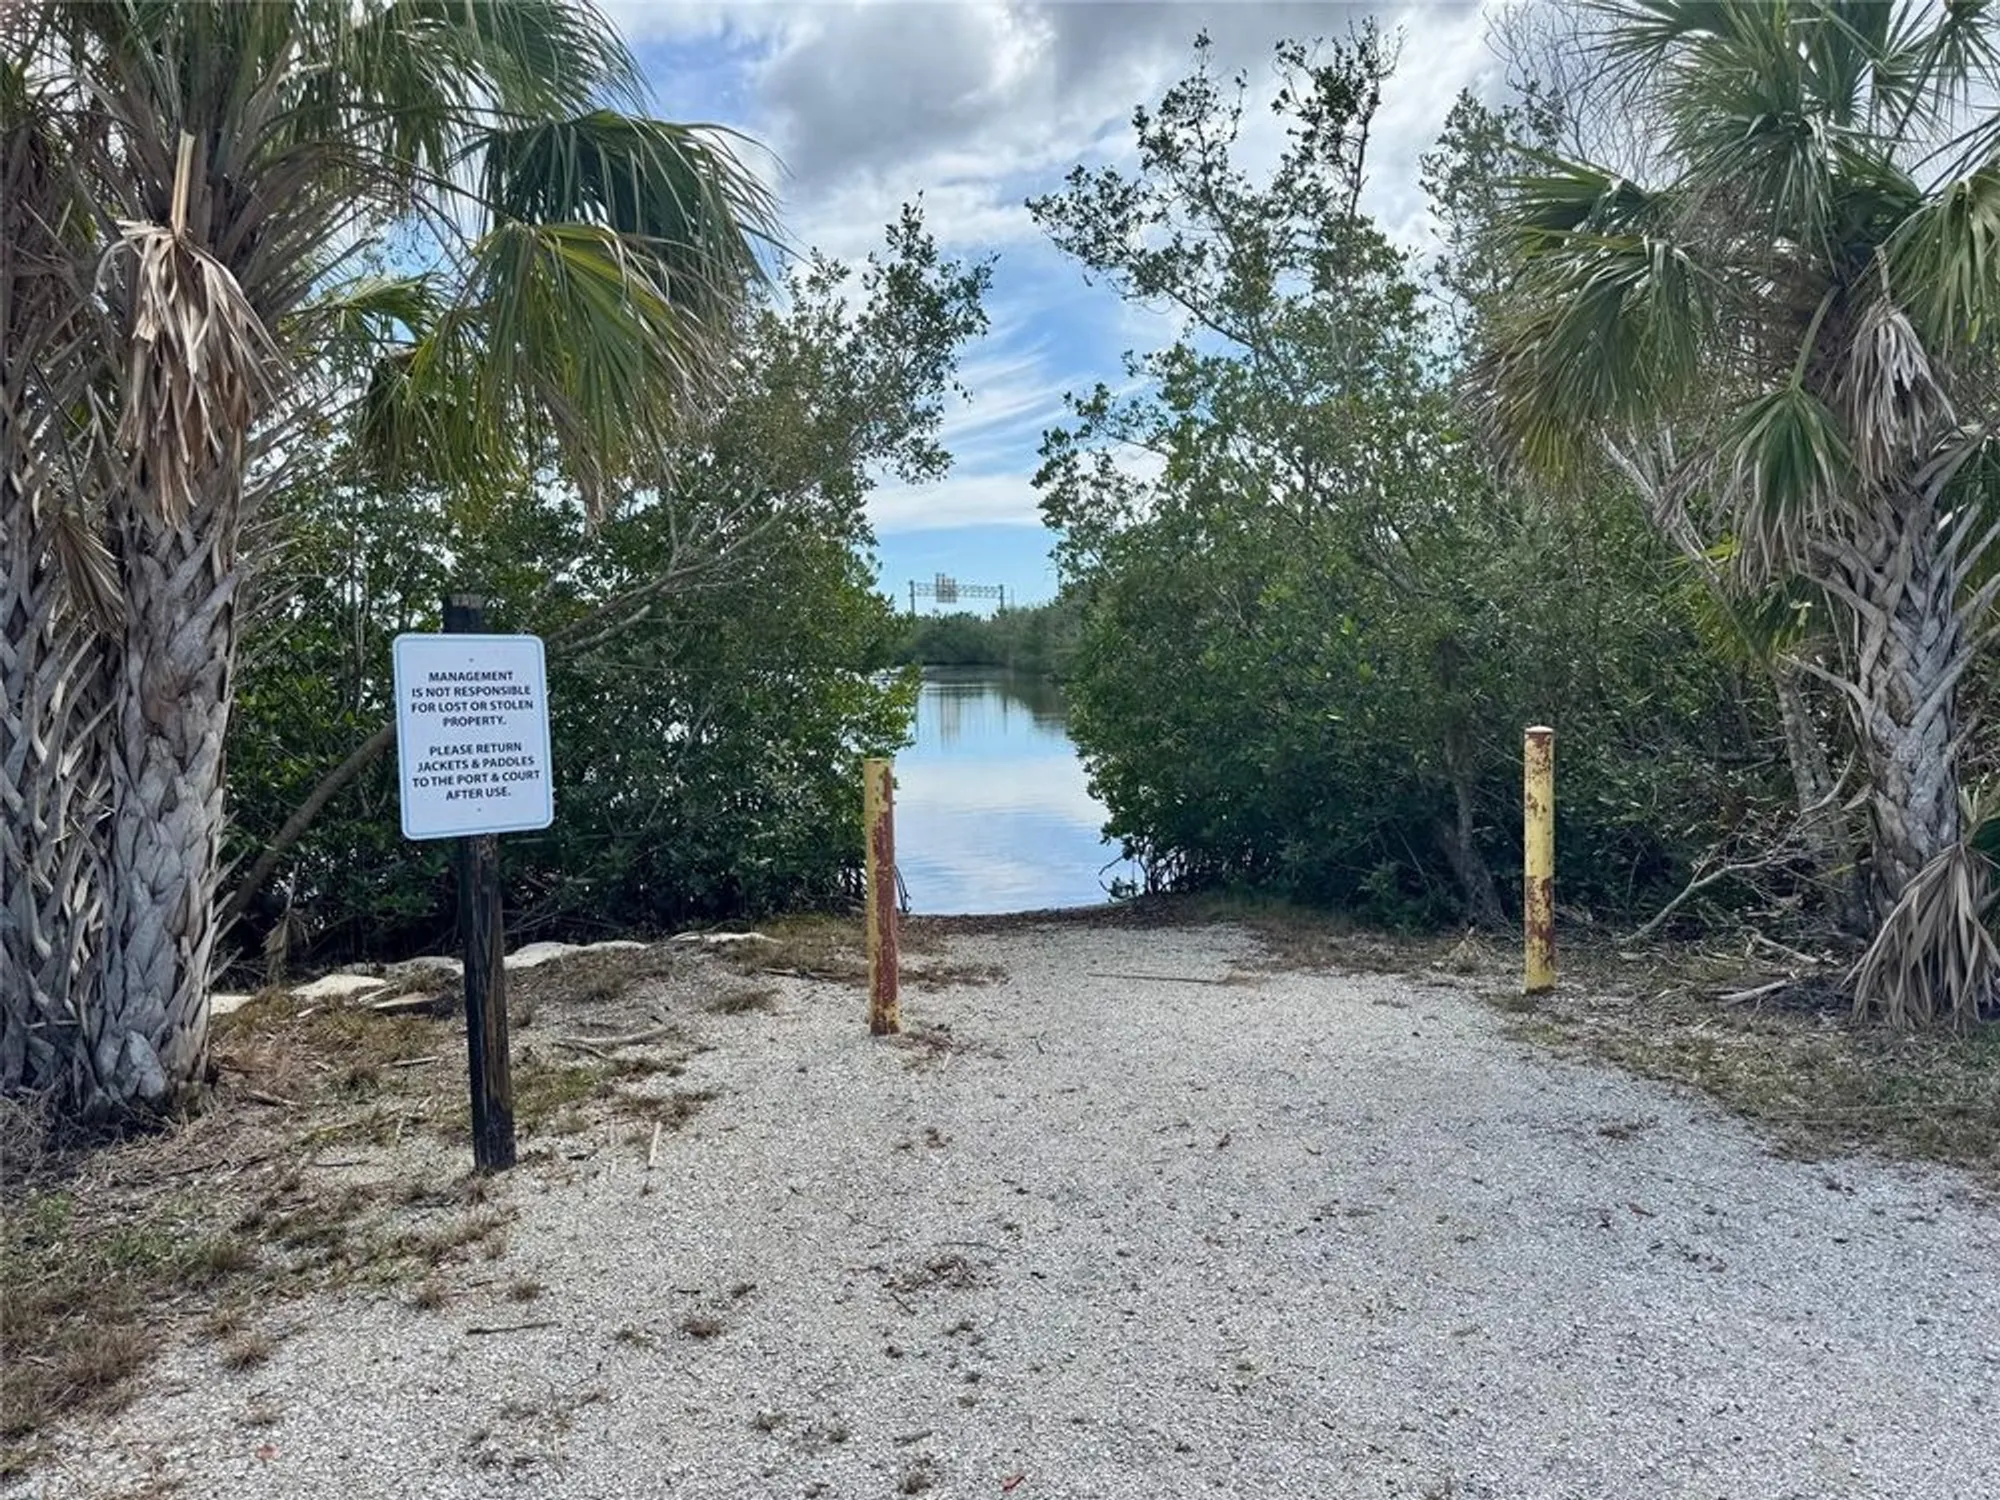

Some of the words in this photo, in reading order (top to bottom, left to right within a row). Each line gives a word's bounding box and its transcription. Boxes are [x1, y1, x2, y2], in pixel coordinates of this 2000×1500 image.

[429, 671, 513, 682] MANAGEMENT
[412, 688, 423, 697] IS
[426, 687, 450, 697] NOT
[454, 685, 531, 697] RESPONSIBLE
[411, 703, 436, 713] FOR
[438, 702, 467, 712] LOST
[470, 702, 487, 711] OR
[490, 700, 533, 710] STOLEN
[443, 716, 506, 727] PROPERTY.
[430, 745, 472, 755] PLEASE
[476, 742, 521, 754] RETURN
[418, 759, 468, 772] JACKETS
[472, 759, 480, 768] &
[483, 756, 534, 768] PADDLES
[413, 778, 429, 787] TO
[432, 777, 454, 786] THE
[457, 774, 487, 785] PORT
[491, 773, 499, 782] &
[502, 771, 540, 781] COURT
[446, 789, 483, 800] AFTER
[486, 786, 511, 797] USE.
